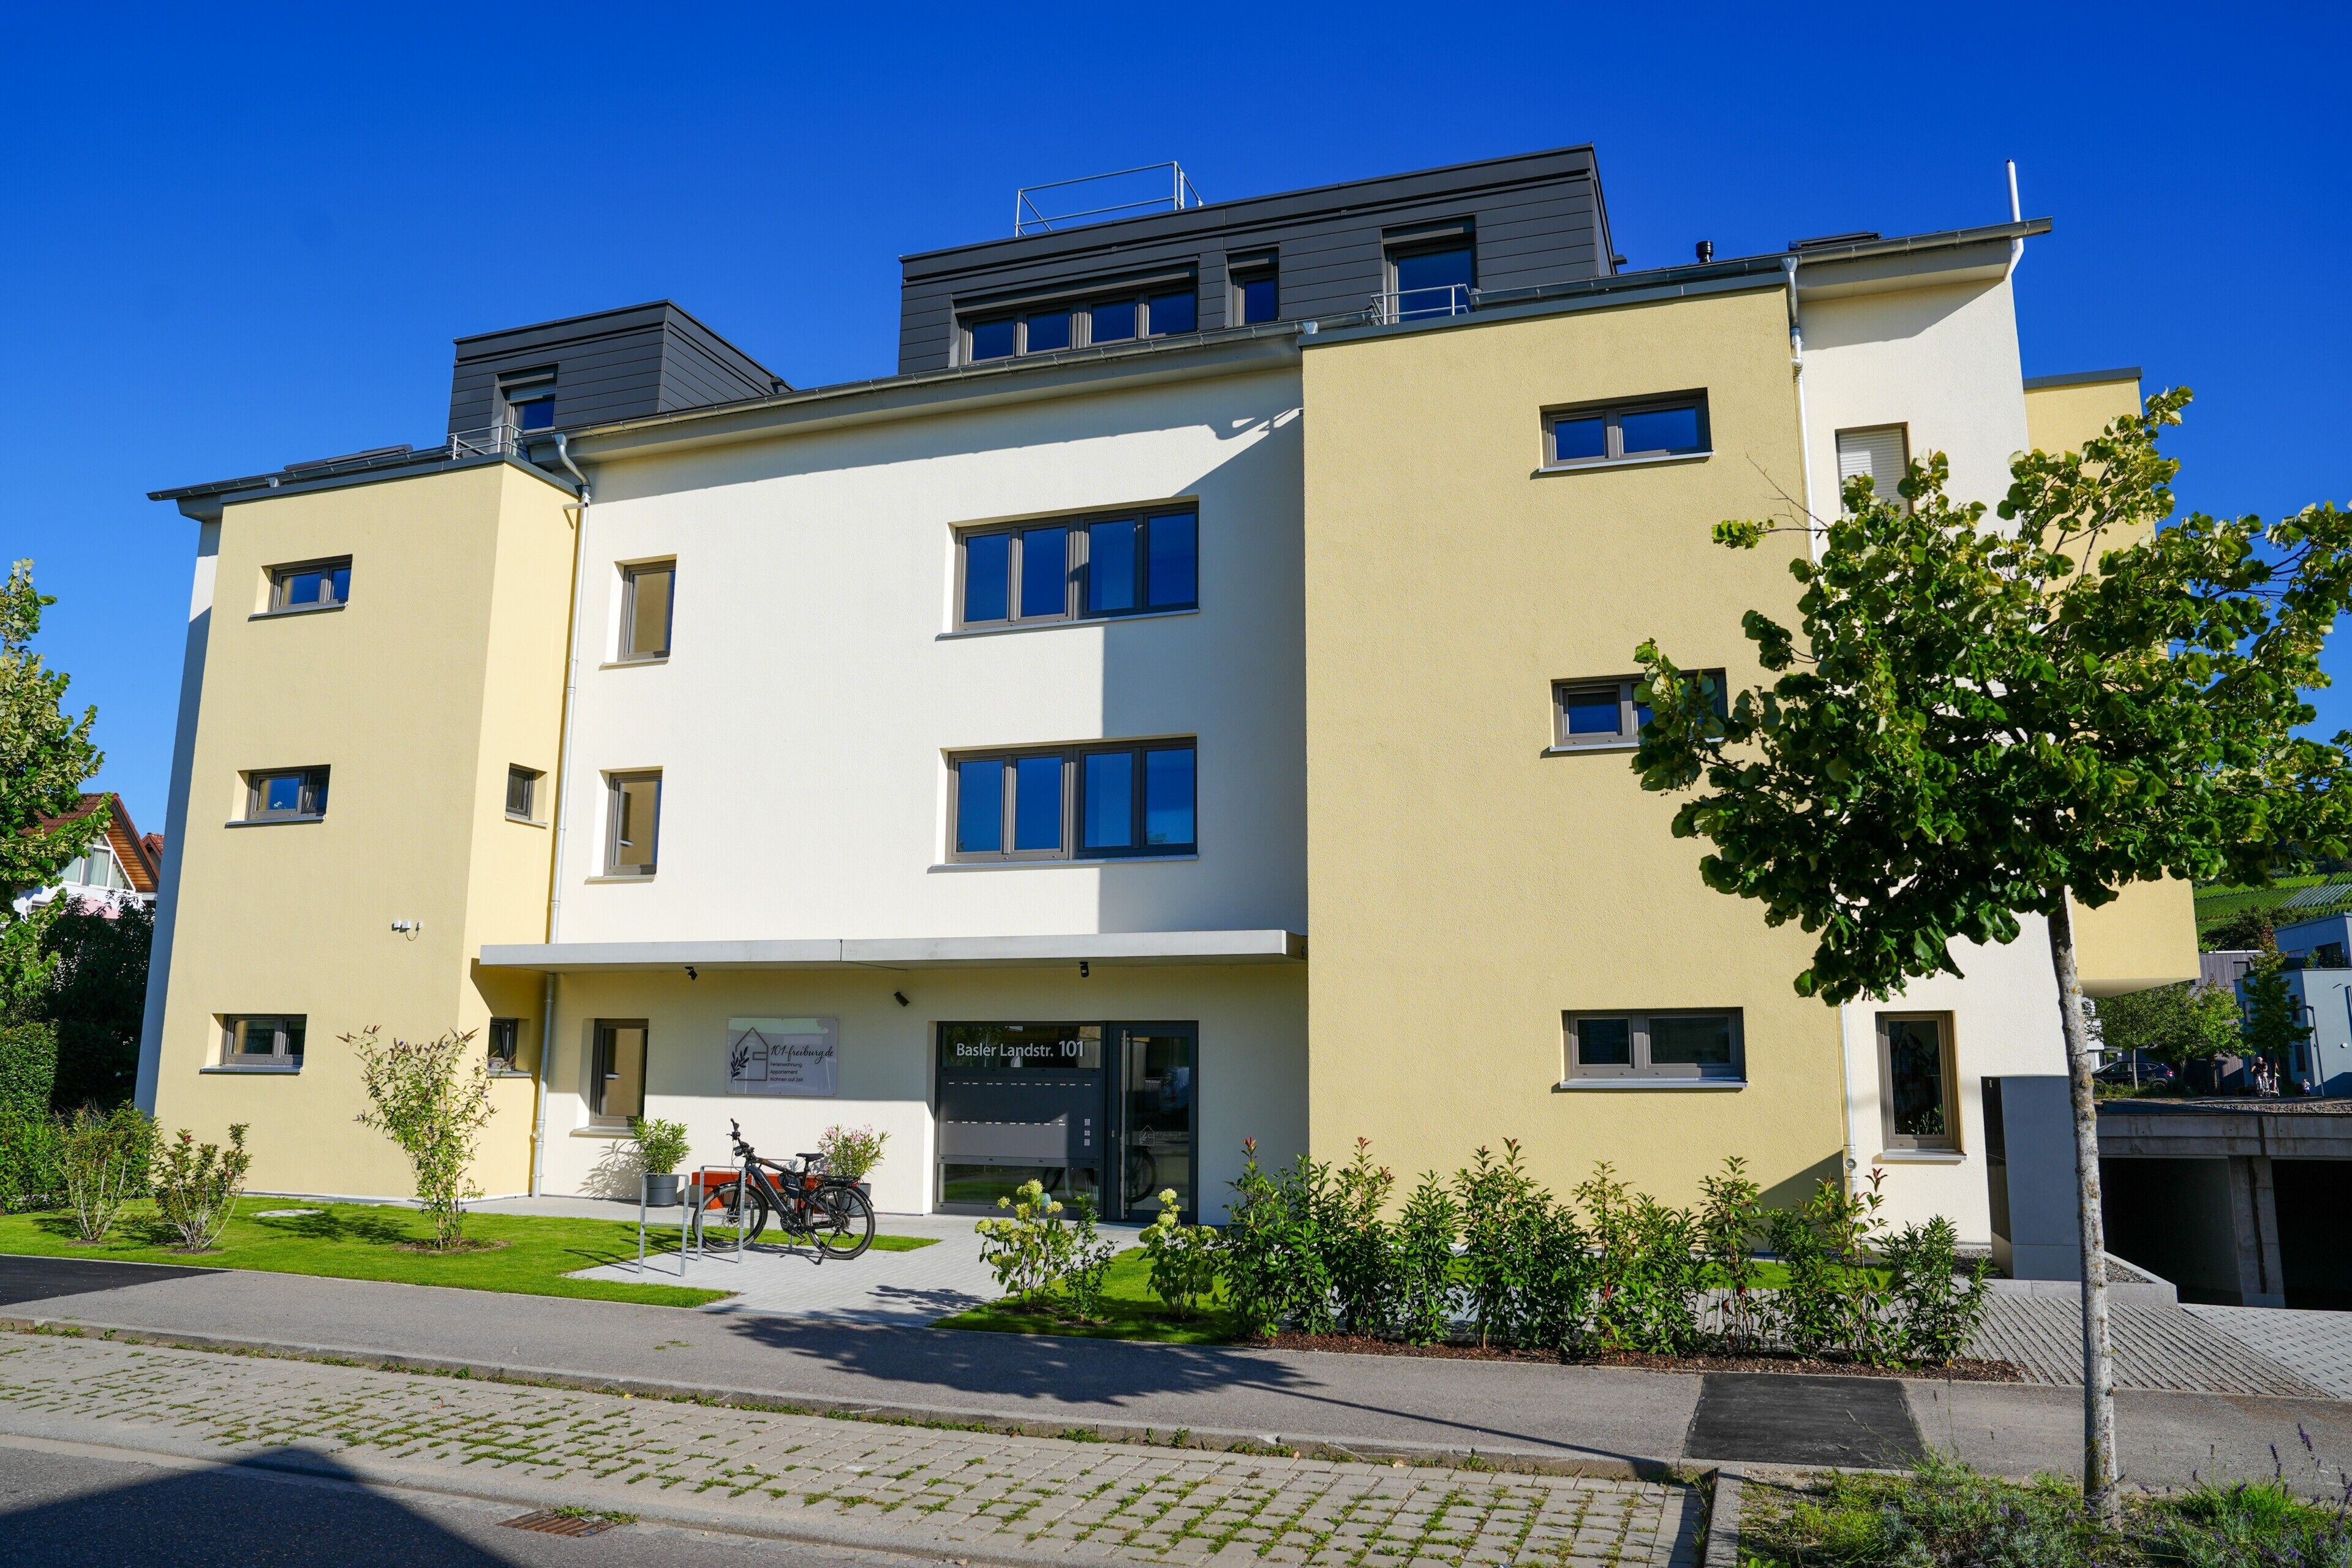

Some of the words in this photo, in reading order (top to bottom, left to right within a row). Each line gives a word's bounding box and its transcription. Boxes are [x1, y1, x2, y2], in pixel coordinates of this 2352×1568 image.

[771, 1045, 833, 1064] 101-freiburg.de
[957, 1043, 997, 1057] Basler
[1000, 1043, 1054, 1057] Landstr.
[1059, 1041, 1084, 1057] 101
